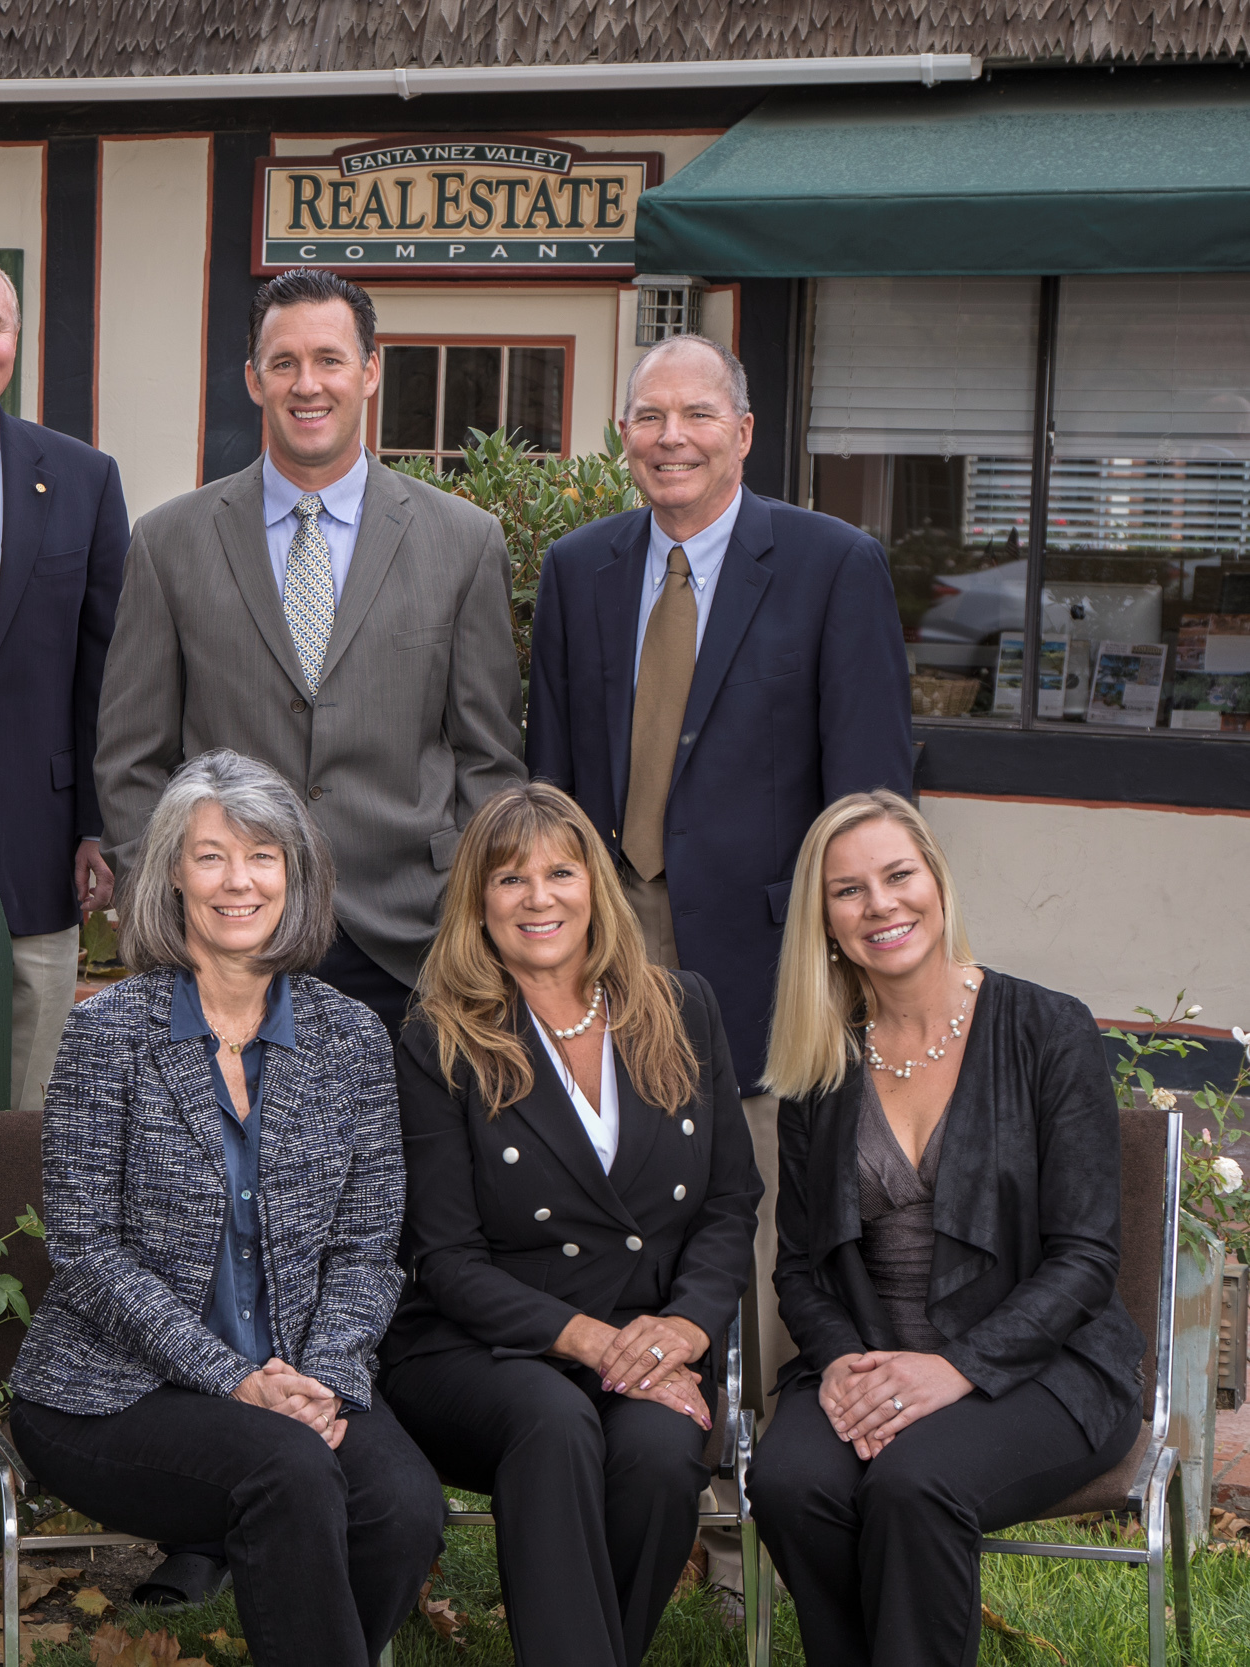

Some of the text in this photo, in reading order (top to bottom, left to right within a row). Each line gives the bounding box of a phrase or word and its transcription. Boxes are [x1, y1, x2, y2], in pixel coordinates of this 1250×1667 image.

[350, 146, 561, 171] SANTA YNEZ VALLEY
[298, 243, 606, 259] COMPANY
